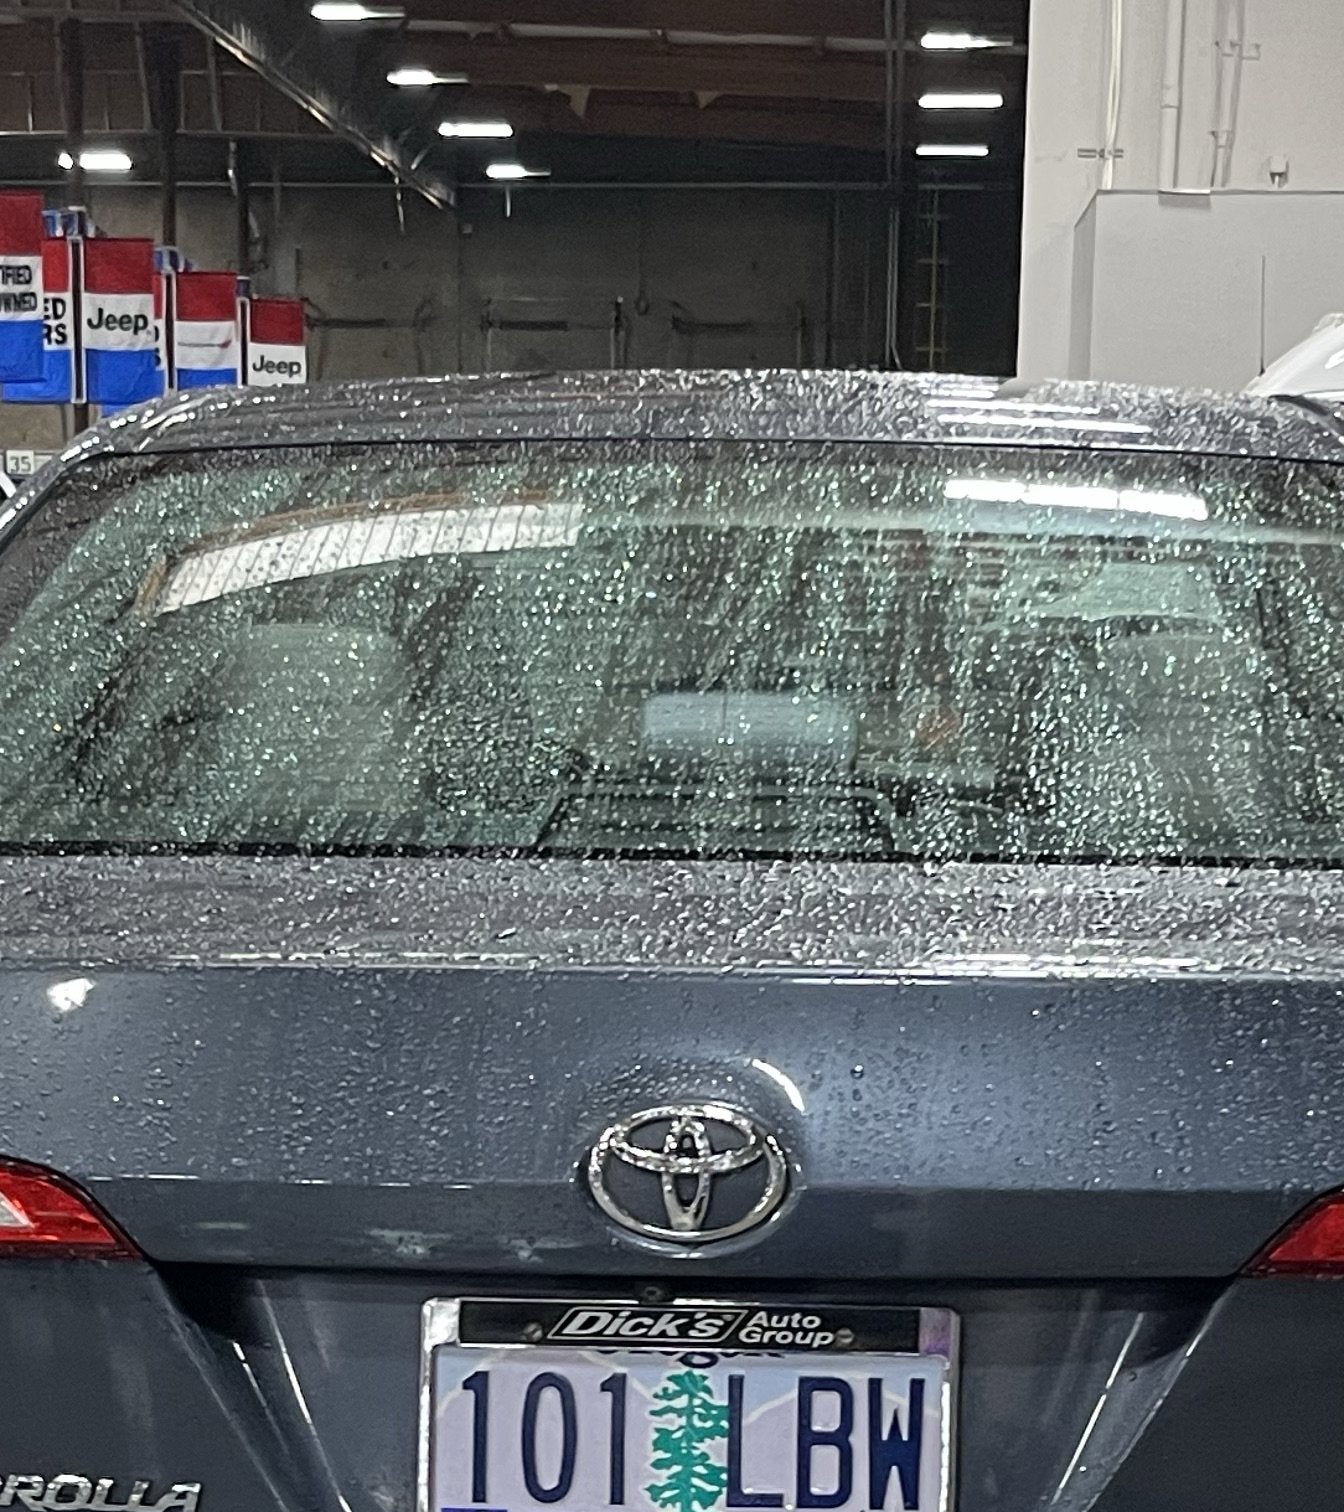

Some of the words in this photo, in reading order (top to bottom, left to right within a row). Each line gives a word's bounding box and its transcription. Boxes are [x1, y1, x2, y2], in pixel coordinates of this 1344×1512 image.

[87, 308, 149, 335] Jeep
[252, 355, 302, 378] Jeep
[10, 456, 32, 473] 35
[561, 1310, 725, 1338] Dick's
[746, 1310, 822, 1330] Auto
[738, 1326, 835, 1349] Group
[728, 1374, 926, 1511] LBW
